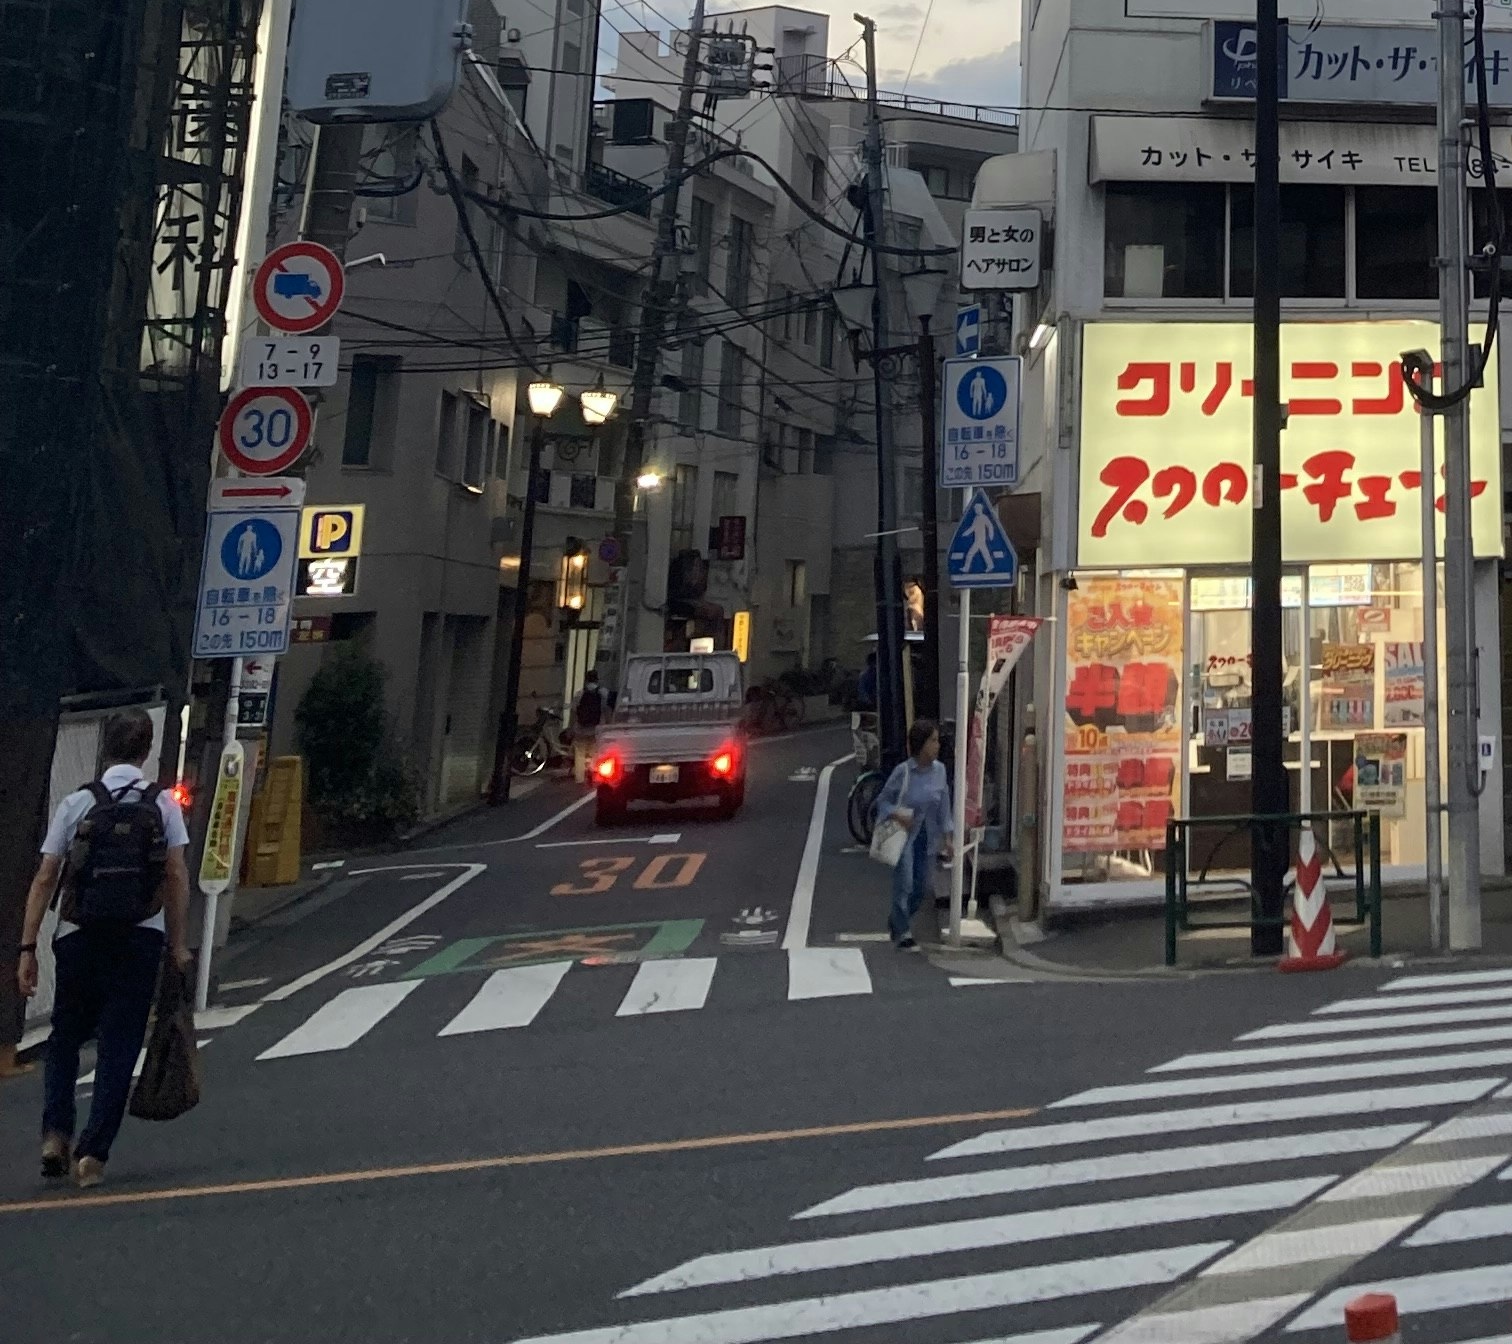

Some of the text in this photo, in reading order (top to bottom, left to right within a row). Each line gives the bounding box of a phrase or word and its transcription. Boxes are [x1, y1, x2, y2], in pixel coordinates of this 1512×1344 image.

[1294, 43, 1510, 85] カット・ザ・イキ
[1393, 156, 1437, 174] TEL
[969, 225, 1035, 245] 男と女の
[966, 257, 1034, 275] ヘアサロン
[258, 362, 323, 380] 13-17
[1115, 360, 1442, 417] クリニン
[240, 408, 292, 449] 30
[948, 424, 1014, 443] 自転車を除く
[977, 462, 1015, 481] 150m
[315, 513, 348, 550] P
[306, 558, 350, 597] 空
[205, 585, 285, 606] 自転車を除く
[239, 630, 284, 649] 150m
[549, 852, 708, 897] 30
